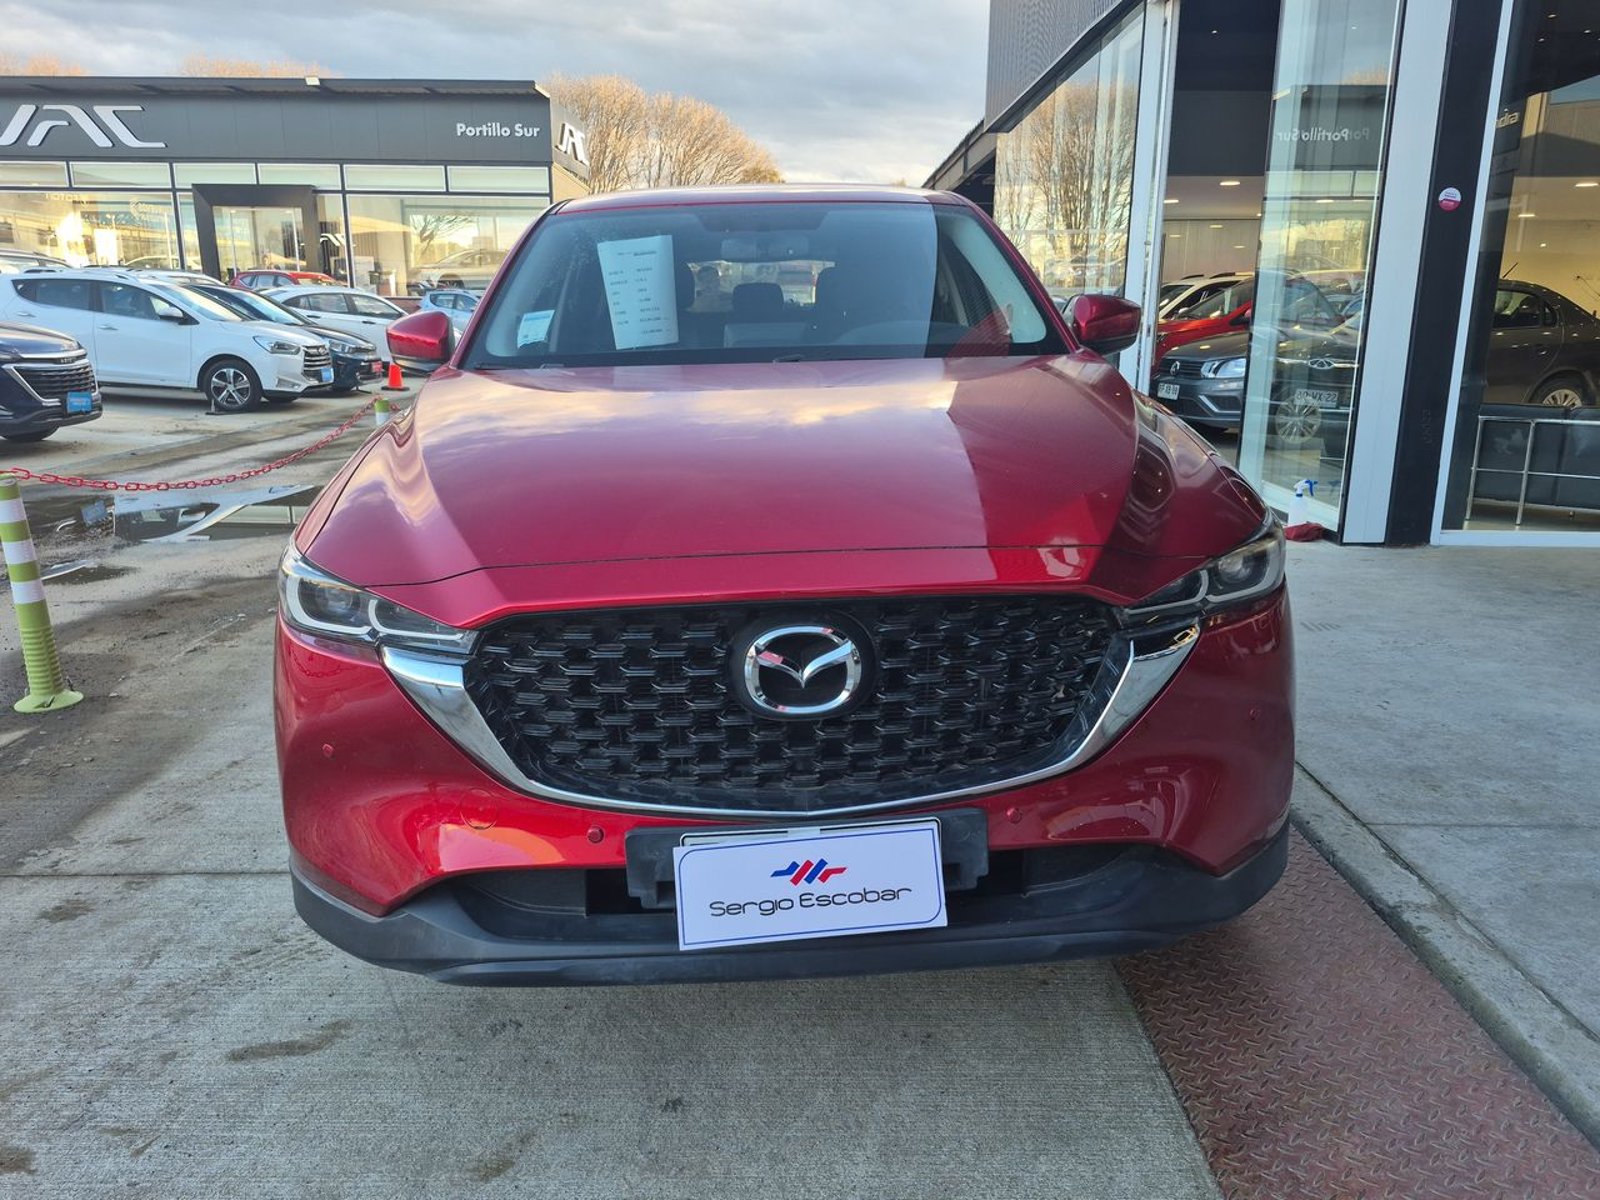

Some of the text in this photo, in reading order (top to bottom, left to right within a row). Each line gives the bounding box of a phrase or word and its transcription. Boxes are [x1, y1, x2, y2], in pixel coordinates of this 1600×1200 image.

[0, 104, 167, 148] JAC
[456, 122, 540, 137] Portillo Sur
[709, 887, 912, 917] Sergio Escobar
